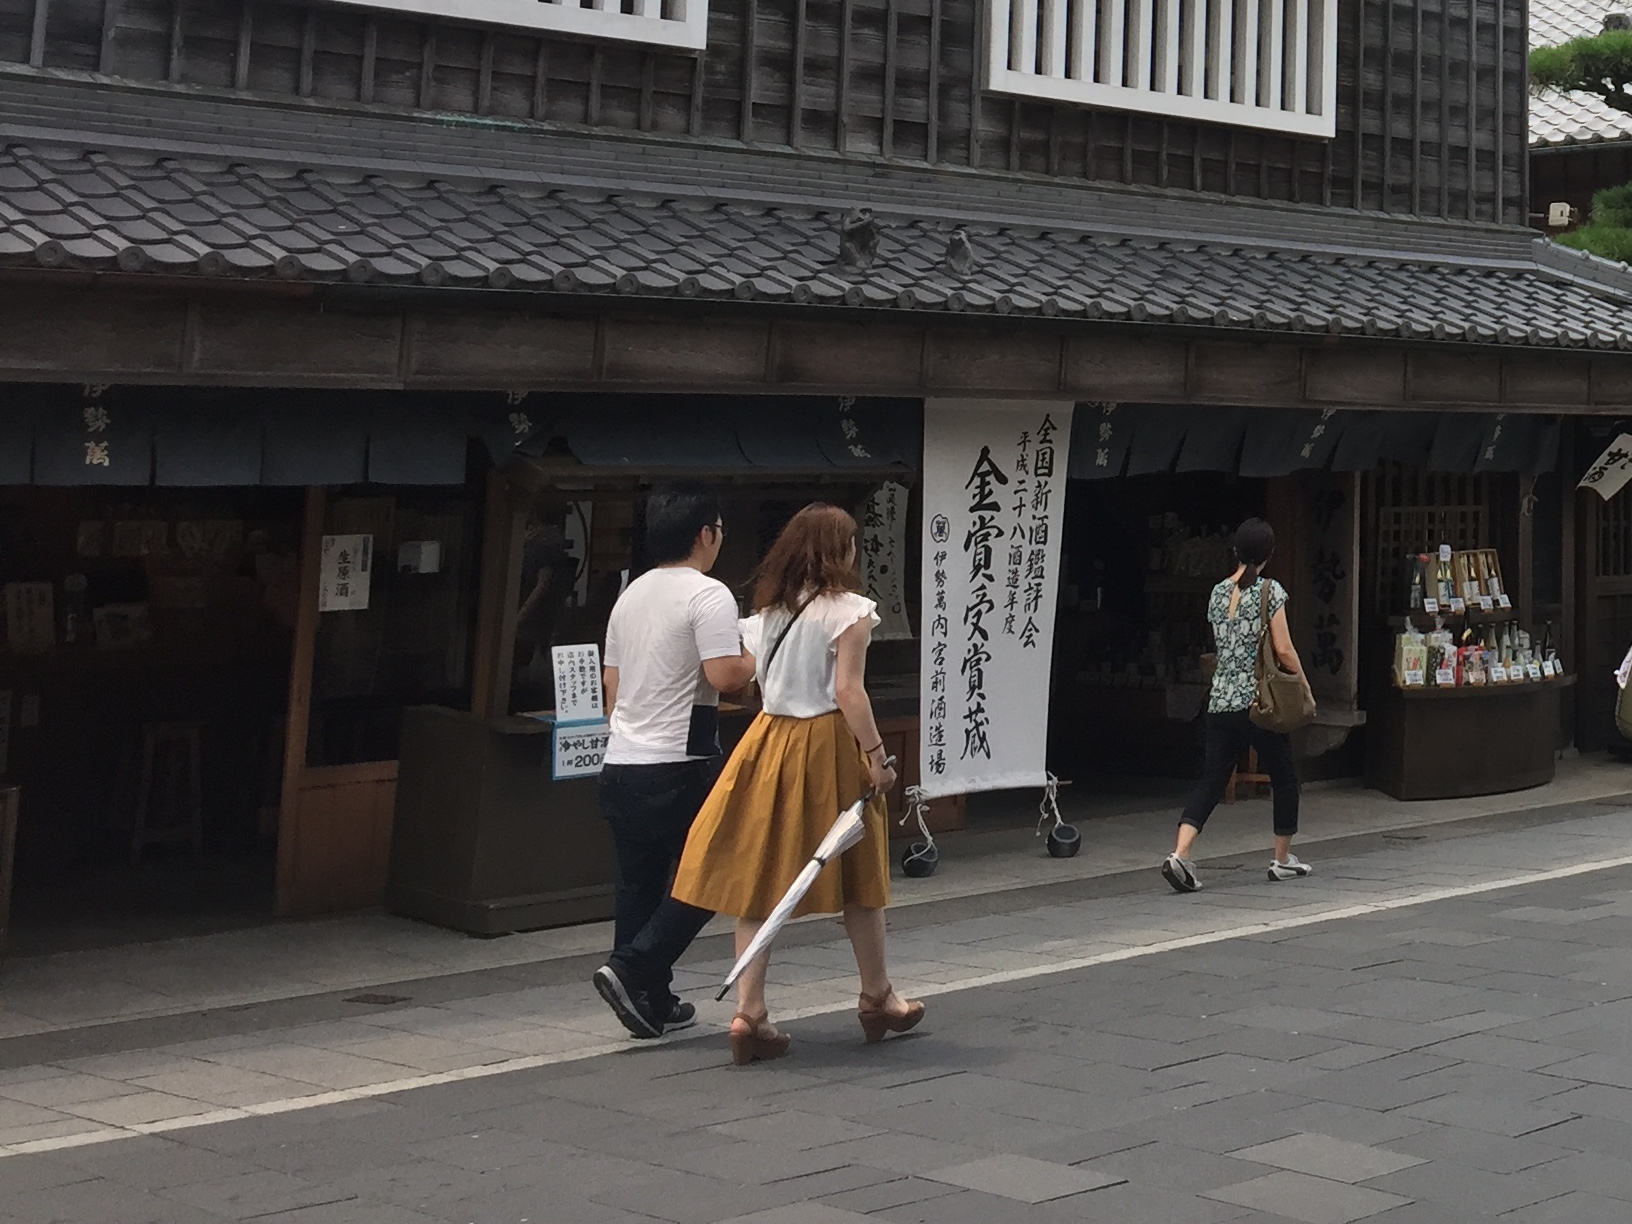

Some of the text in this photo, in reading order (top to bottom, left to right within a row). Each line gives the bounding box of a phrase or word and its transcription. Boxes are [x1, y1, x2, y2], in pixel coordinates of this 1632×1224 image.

[335, 549, 351, 597] 生原酒
[960, 445, 1009, 760] 金賞受賞蔵
[1002, 431, 1032, 636] 平成二十八酒造年度
[1018, 413, 1058, 649] 全国新酒鑑評会
[928, 551, 949, 774] 伊勢萬内宮前酒造場
